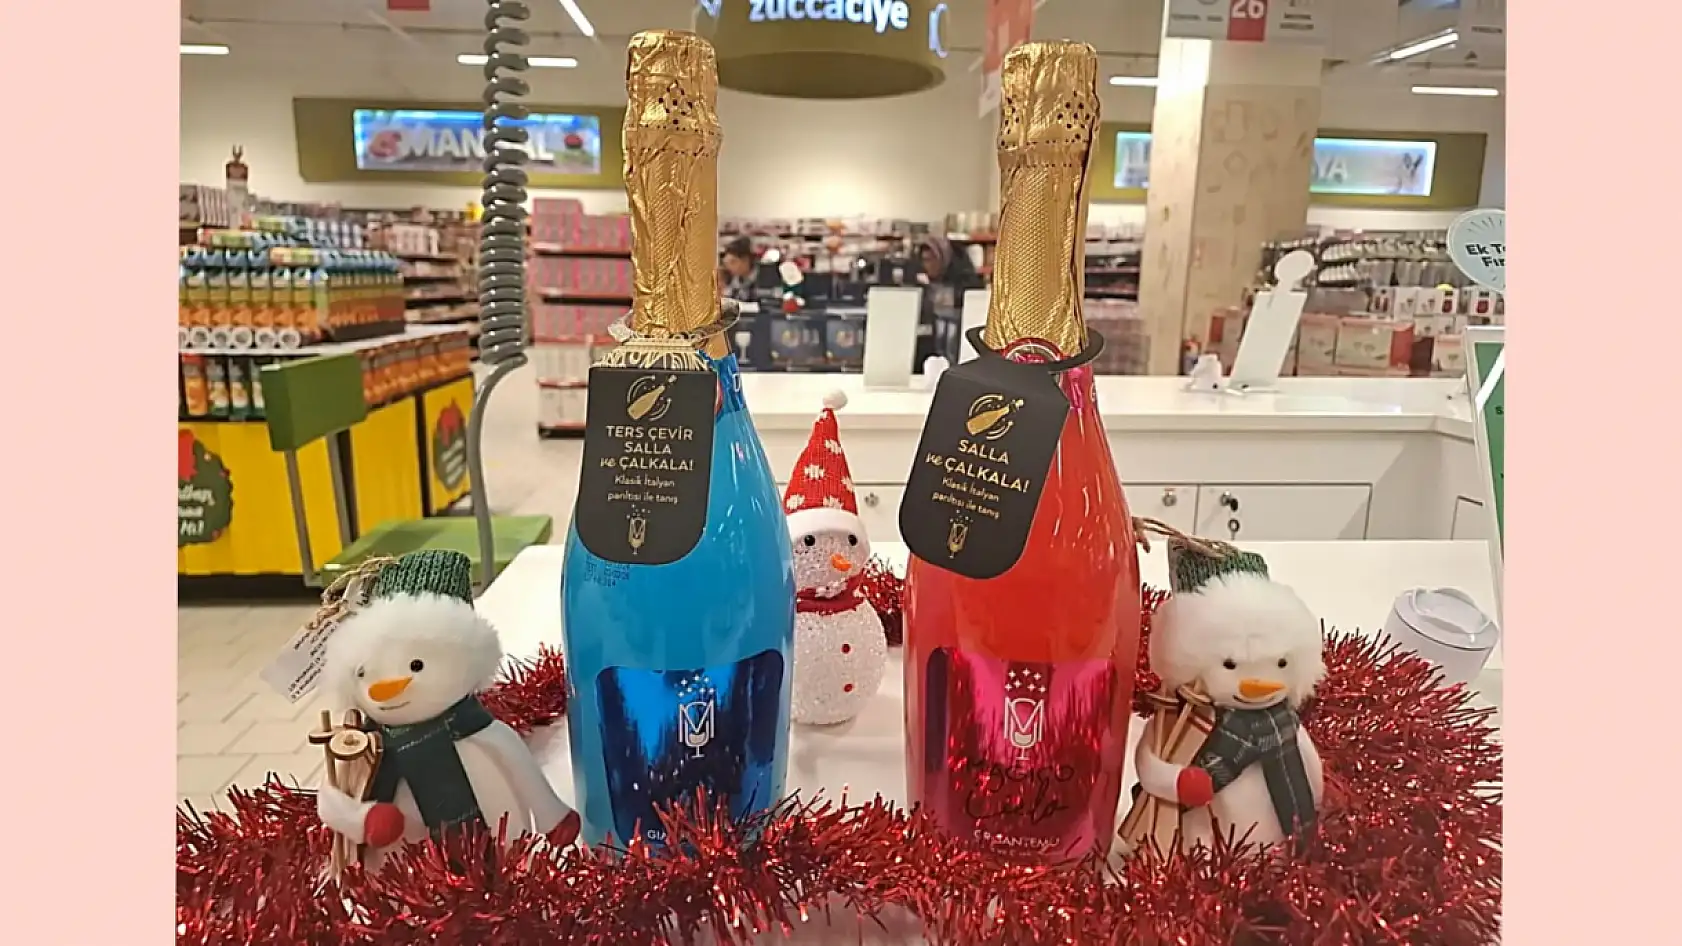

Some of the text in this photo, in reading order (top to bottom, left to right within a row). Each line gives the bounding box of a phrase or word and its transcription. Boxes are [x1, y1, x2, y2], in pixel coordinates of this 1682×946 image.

[1231, 0, 1265, 19] 26
[1465, 243, 1505, 255] Ek T
[606, 425, 693, 441] TERS ÇEVİR
[624, 441, 672, 454] SALLA
[958, 439, 1009, 465] SALLA
[619, 456, 694, 471] ÇALKALA!
[944, 457, 1030, 493] ÇALKALA!
[647, 829, 667, 840] GIA
